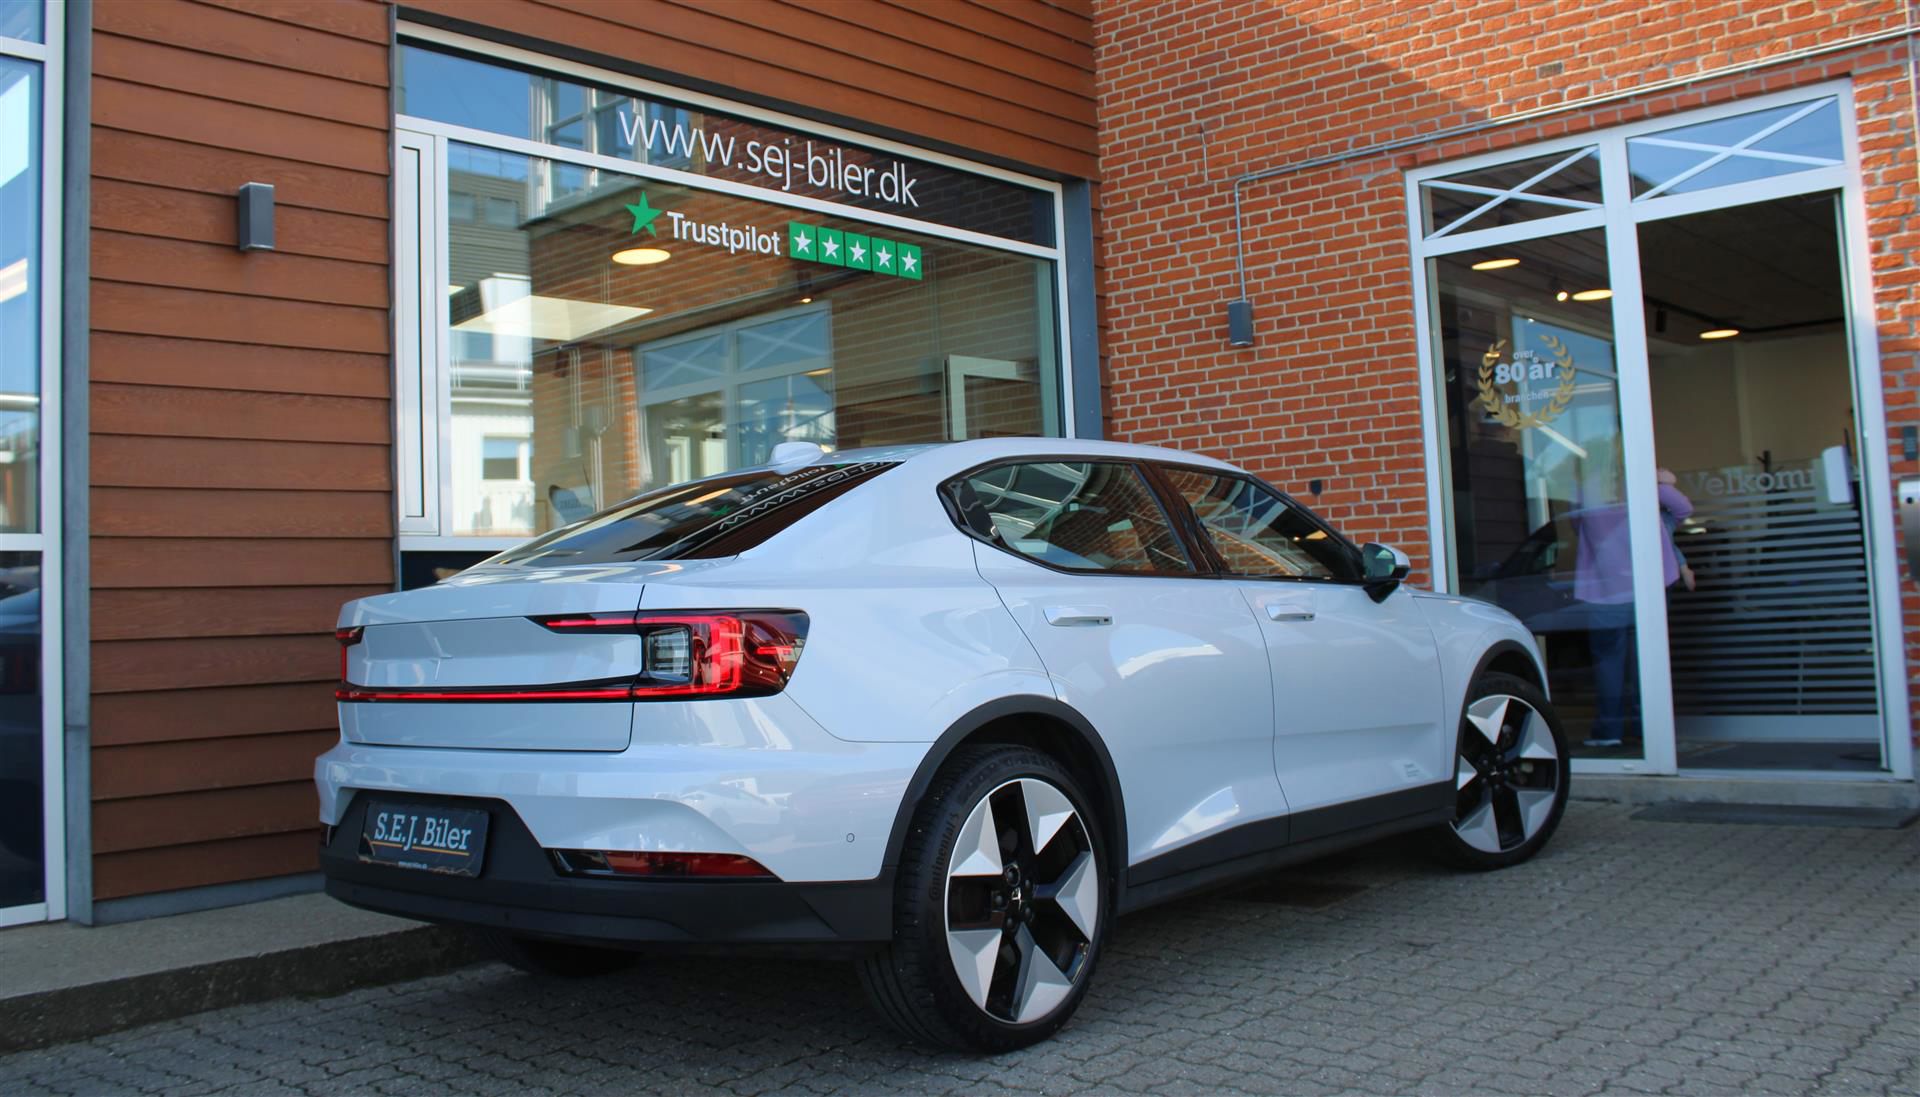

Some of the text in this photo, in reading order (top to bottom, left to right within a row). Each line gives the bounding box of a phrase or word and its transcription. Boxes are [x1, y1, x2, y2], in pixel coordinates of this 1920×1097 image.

[619, 111, 920, 208] www.sej-biler.dk
[666, 210, 782, 256] Trustpilot
[1495, 355, 1556, 385] 80 år
[1513, 350, 1535, 360] over
[374, 812, 472, 851] S.E.J. Biler
